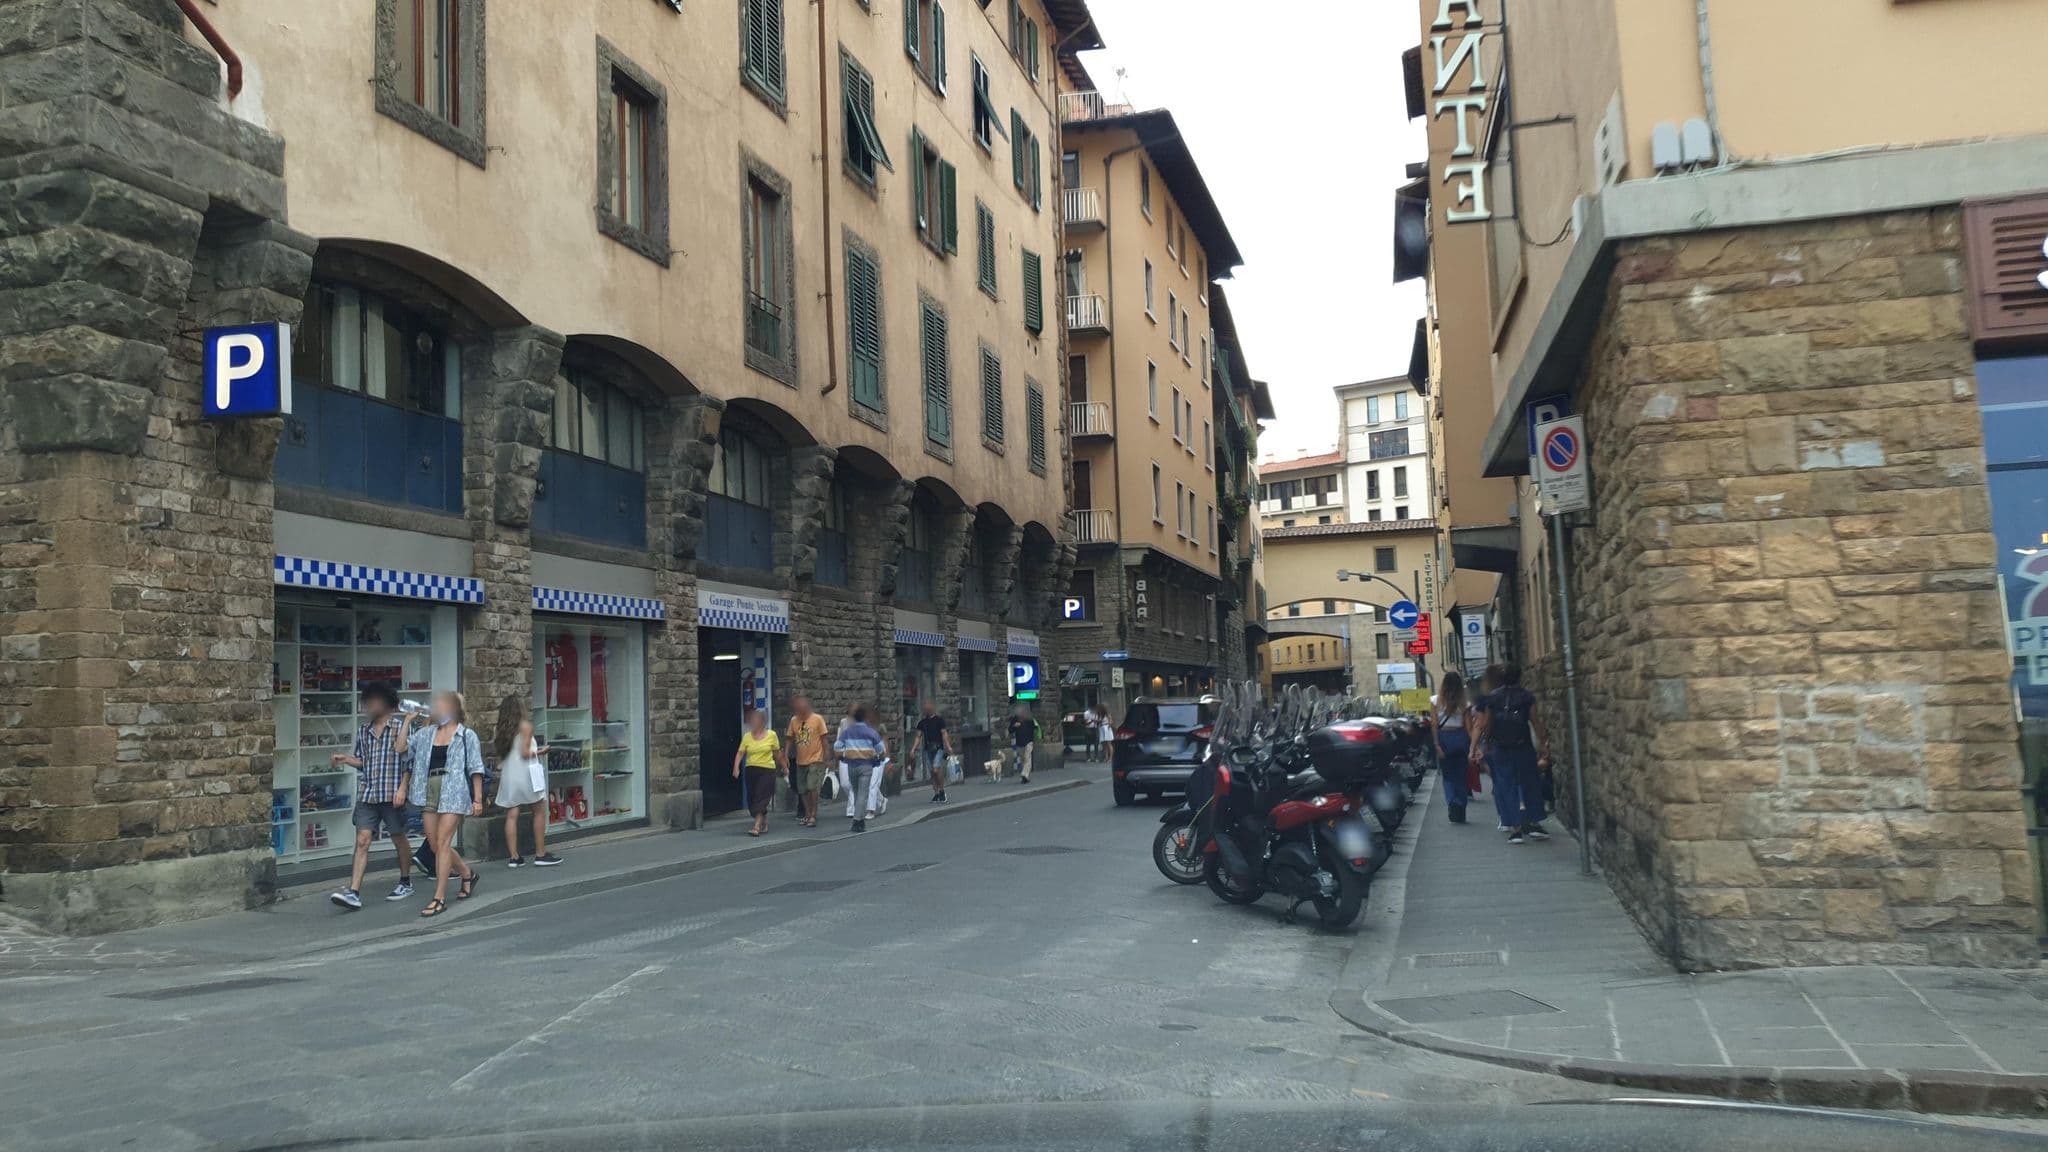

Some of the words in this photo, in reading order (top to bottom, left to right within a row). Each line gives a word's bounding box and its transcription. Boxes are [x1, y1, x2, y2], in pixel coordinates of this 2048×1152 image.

[216, 333, 264, 410] P
[709, 594, 734, 610] Garage
[756, 600, 779, 613] Vecchio
[1064, 598, 1080, 618] P
[1007, 662, 1034, 698] P
